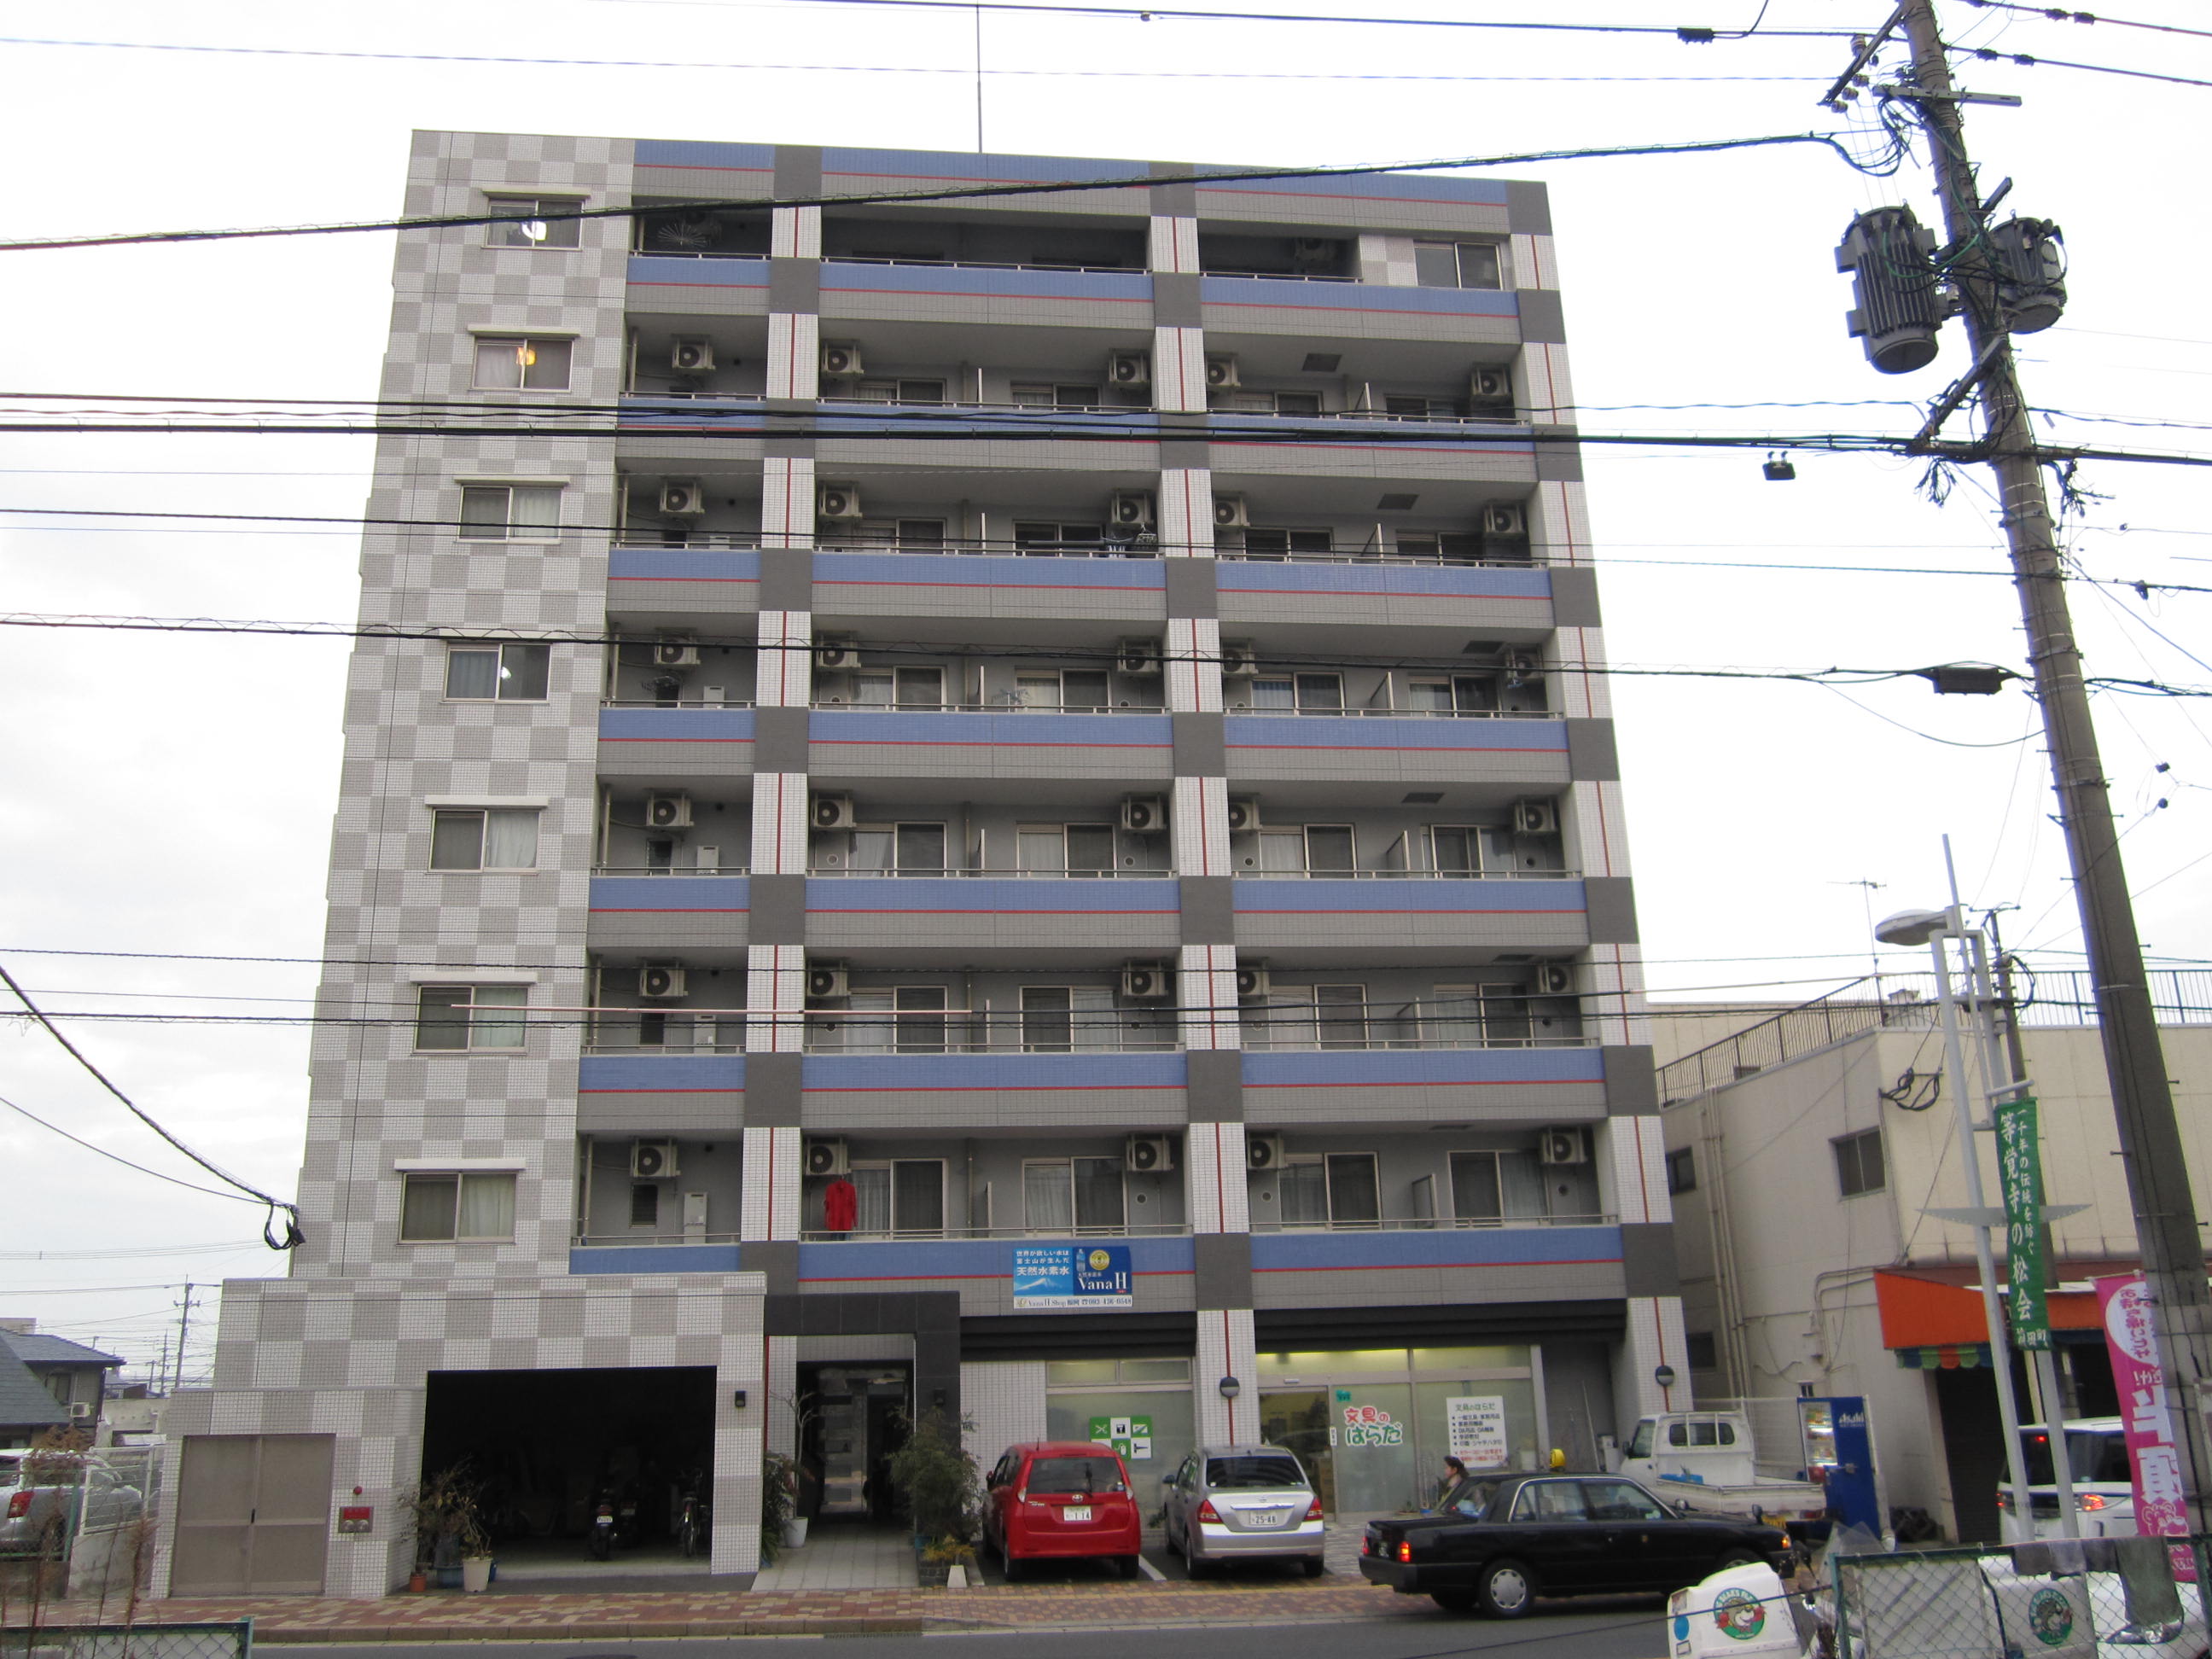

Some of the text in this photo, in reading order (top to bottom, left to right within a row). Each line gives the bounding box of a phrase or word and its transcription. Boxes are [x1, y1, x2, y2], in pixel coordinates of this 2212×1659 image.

[2000, 1111, 2033, 1321] 等覚寺の松会
[1016, 1266, 1070, 1276] 天然水素水
[1345, 1406, 1390, 1424] 文具の
[1346, 1423, 1402, 1445] はらだ
